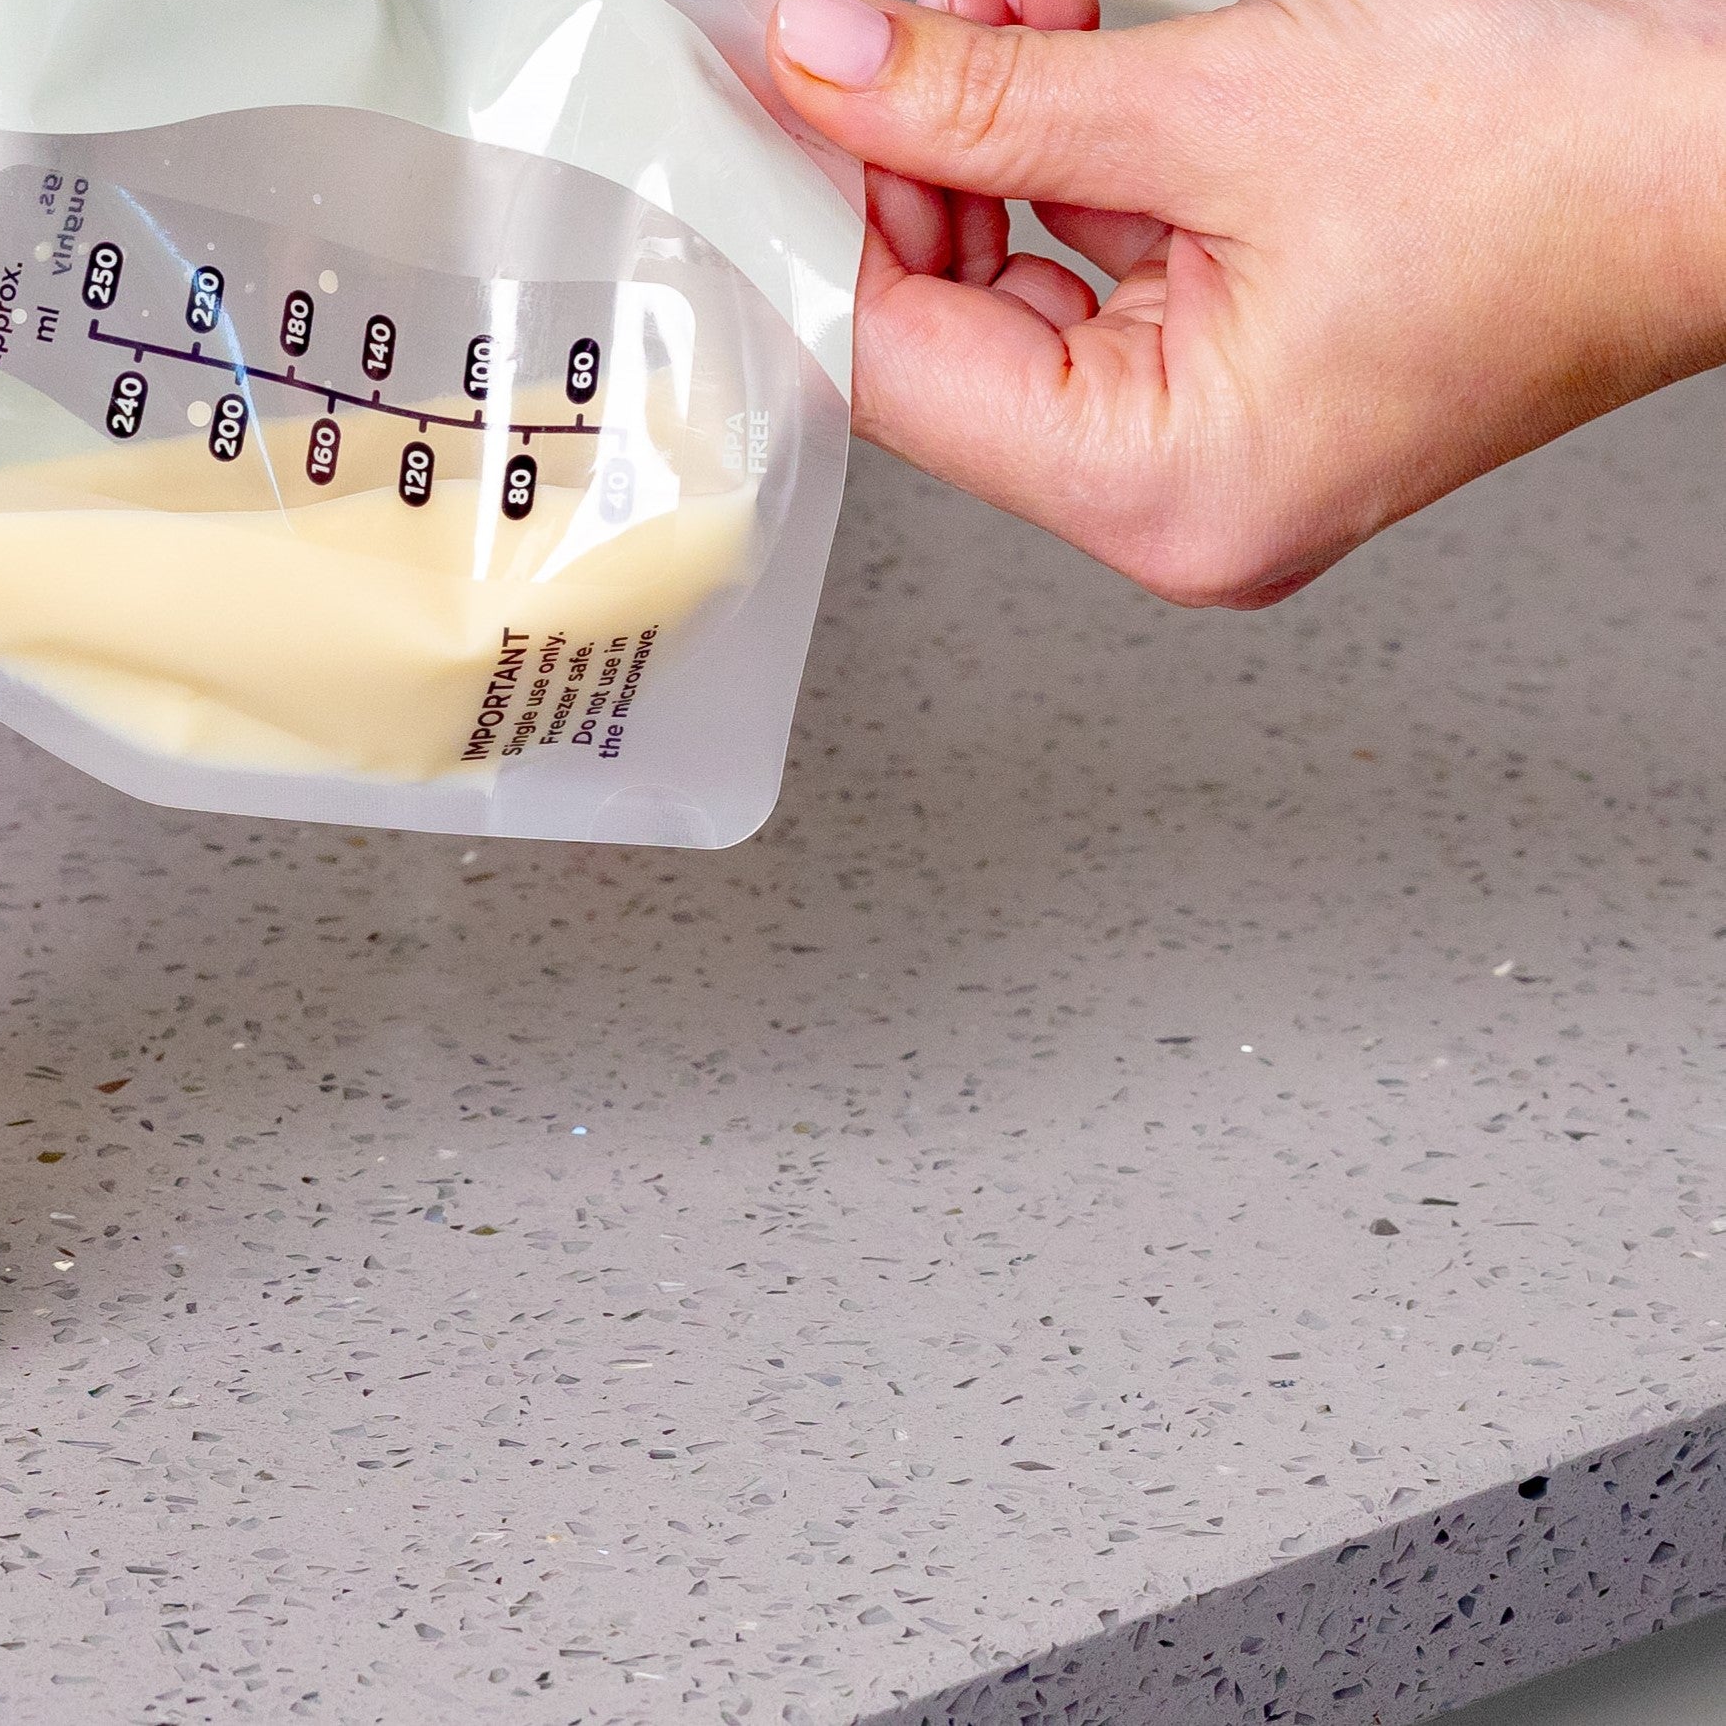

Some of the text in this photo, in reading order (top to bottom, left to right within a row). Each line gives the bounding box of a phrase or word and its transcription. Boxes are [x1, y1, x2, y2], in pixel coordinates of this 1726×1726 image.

[87, 248, 119, 304] 250
[191, 271, 221, 327] 220
[35, 306, 61, 343] ml
[284, 298, 311, 347] 180
[366, 321, 393, 371] 140
[468, 341, 493, 392] 100
[571, 351, 595, 389] 60
[110, 375, 144, 434] 240
[214, 398, 246, 458] 200
[309, 426, 337, 475] 160
[748, 409, 770, 475] FREE
[403, 450, 430, 497] 120
[507, 467, 532, 505] 80
[606, 470, 630, 510] 40
[460, 627, 530, 762] IMPORTANT
[501, 631, 567, 757] Single use only.
[539, 641, 595, 745] Freezer safe.
[571, 635, 629, 746] Do not use in
[597, 624, 660, 759] the microwave.
